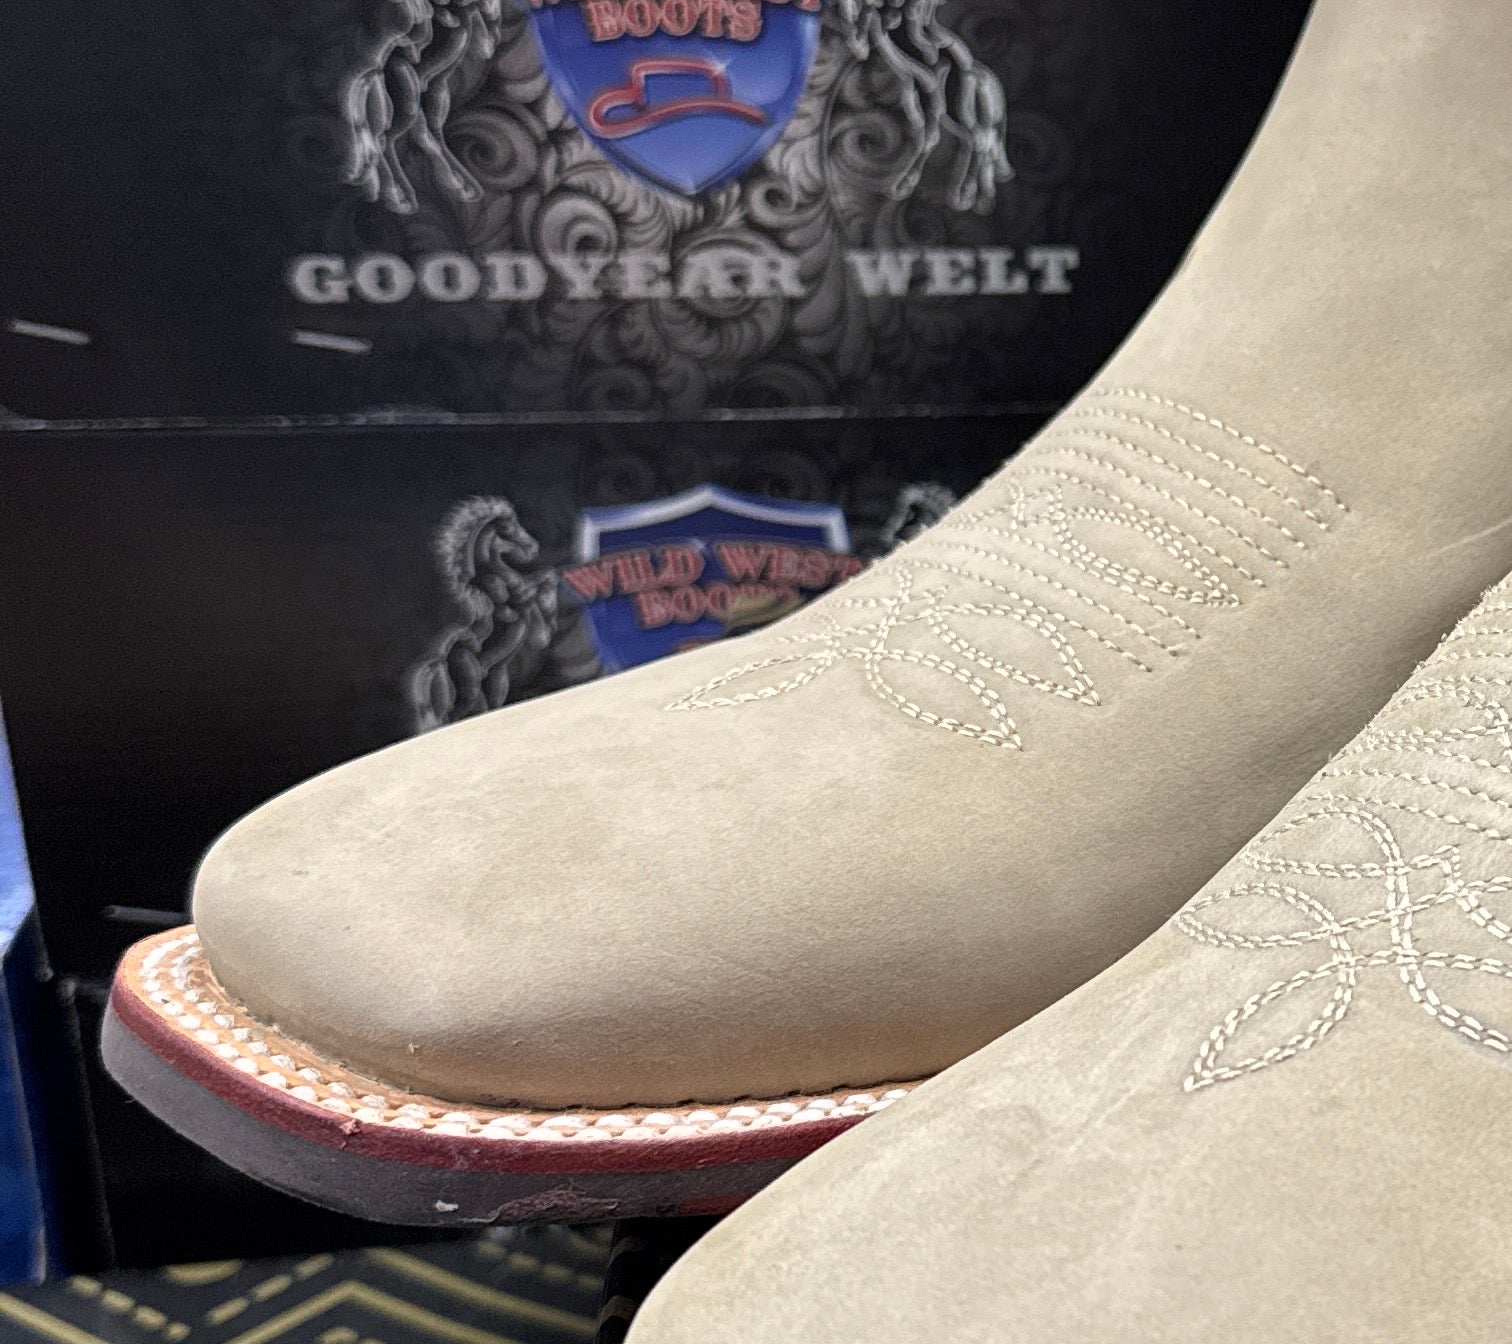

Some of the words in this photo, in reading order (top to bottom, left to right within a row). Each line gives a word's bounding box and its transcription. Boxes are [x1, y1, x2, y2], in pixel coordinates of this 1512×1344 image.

[290, 253, 803, 304] GOODYEAR
[845, 248, 1081, 297] WELT
[562, 546, 706, 601] WILD
